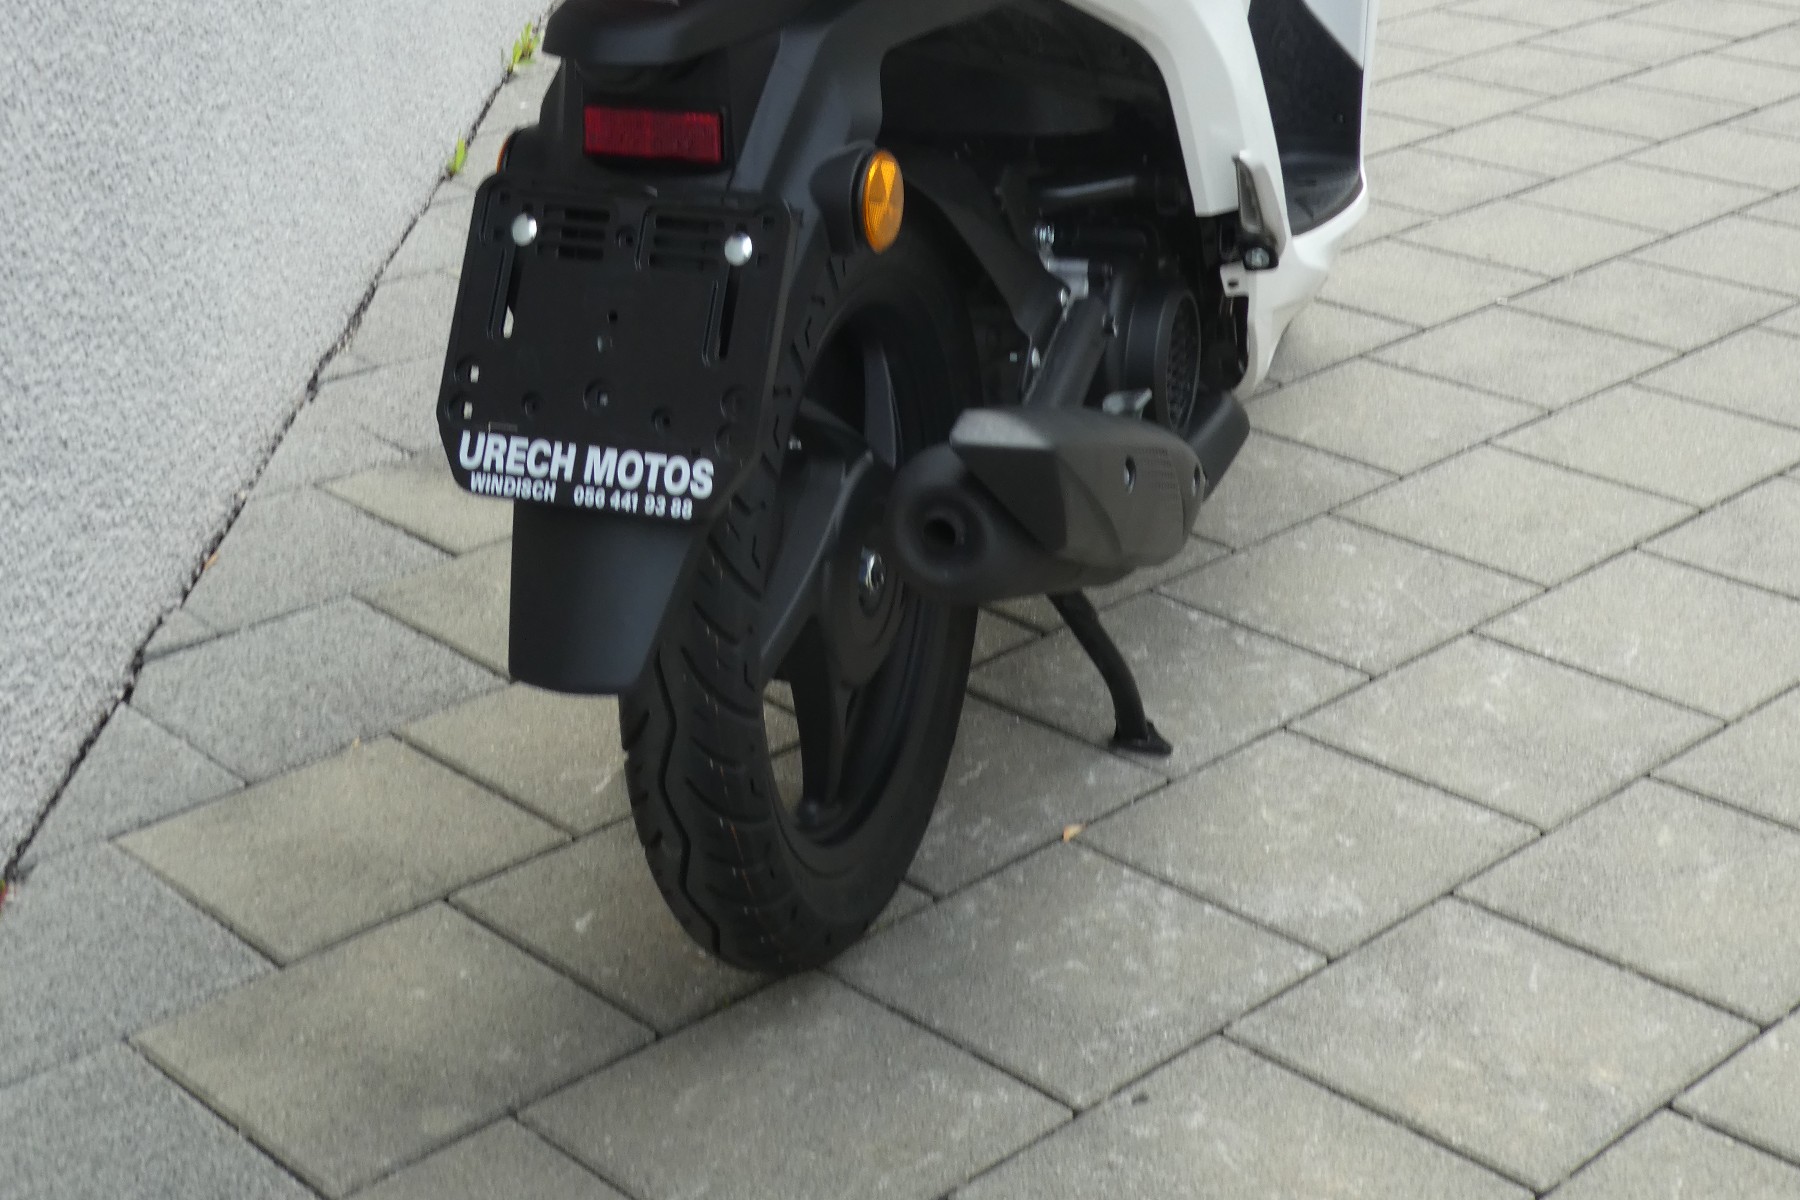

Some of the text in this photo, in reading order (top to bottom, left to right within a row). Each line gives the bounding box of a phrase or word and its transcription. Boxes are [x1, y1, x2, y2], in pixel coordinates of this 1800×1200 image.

[459, 430, 714, 499] URECH MOTOS
[471, 471, 556, 503] WINDISCH
[610, 489, 638, 514] 441
